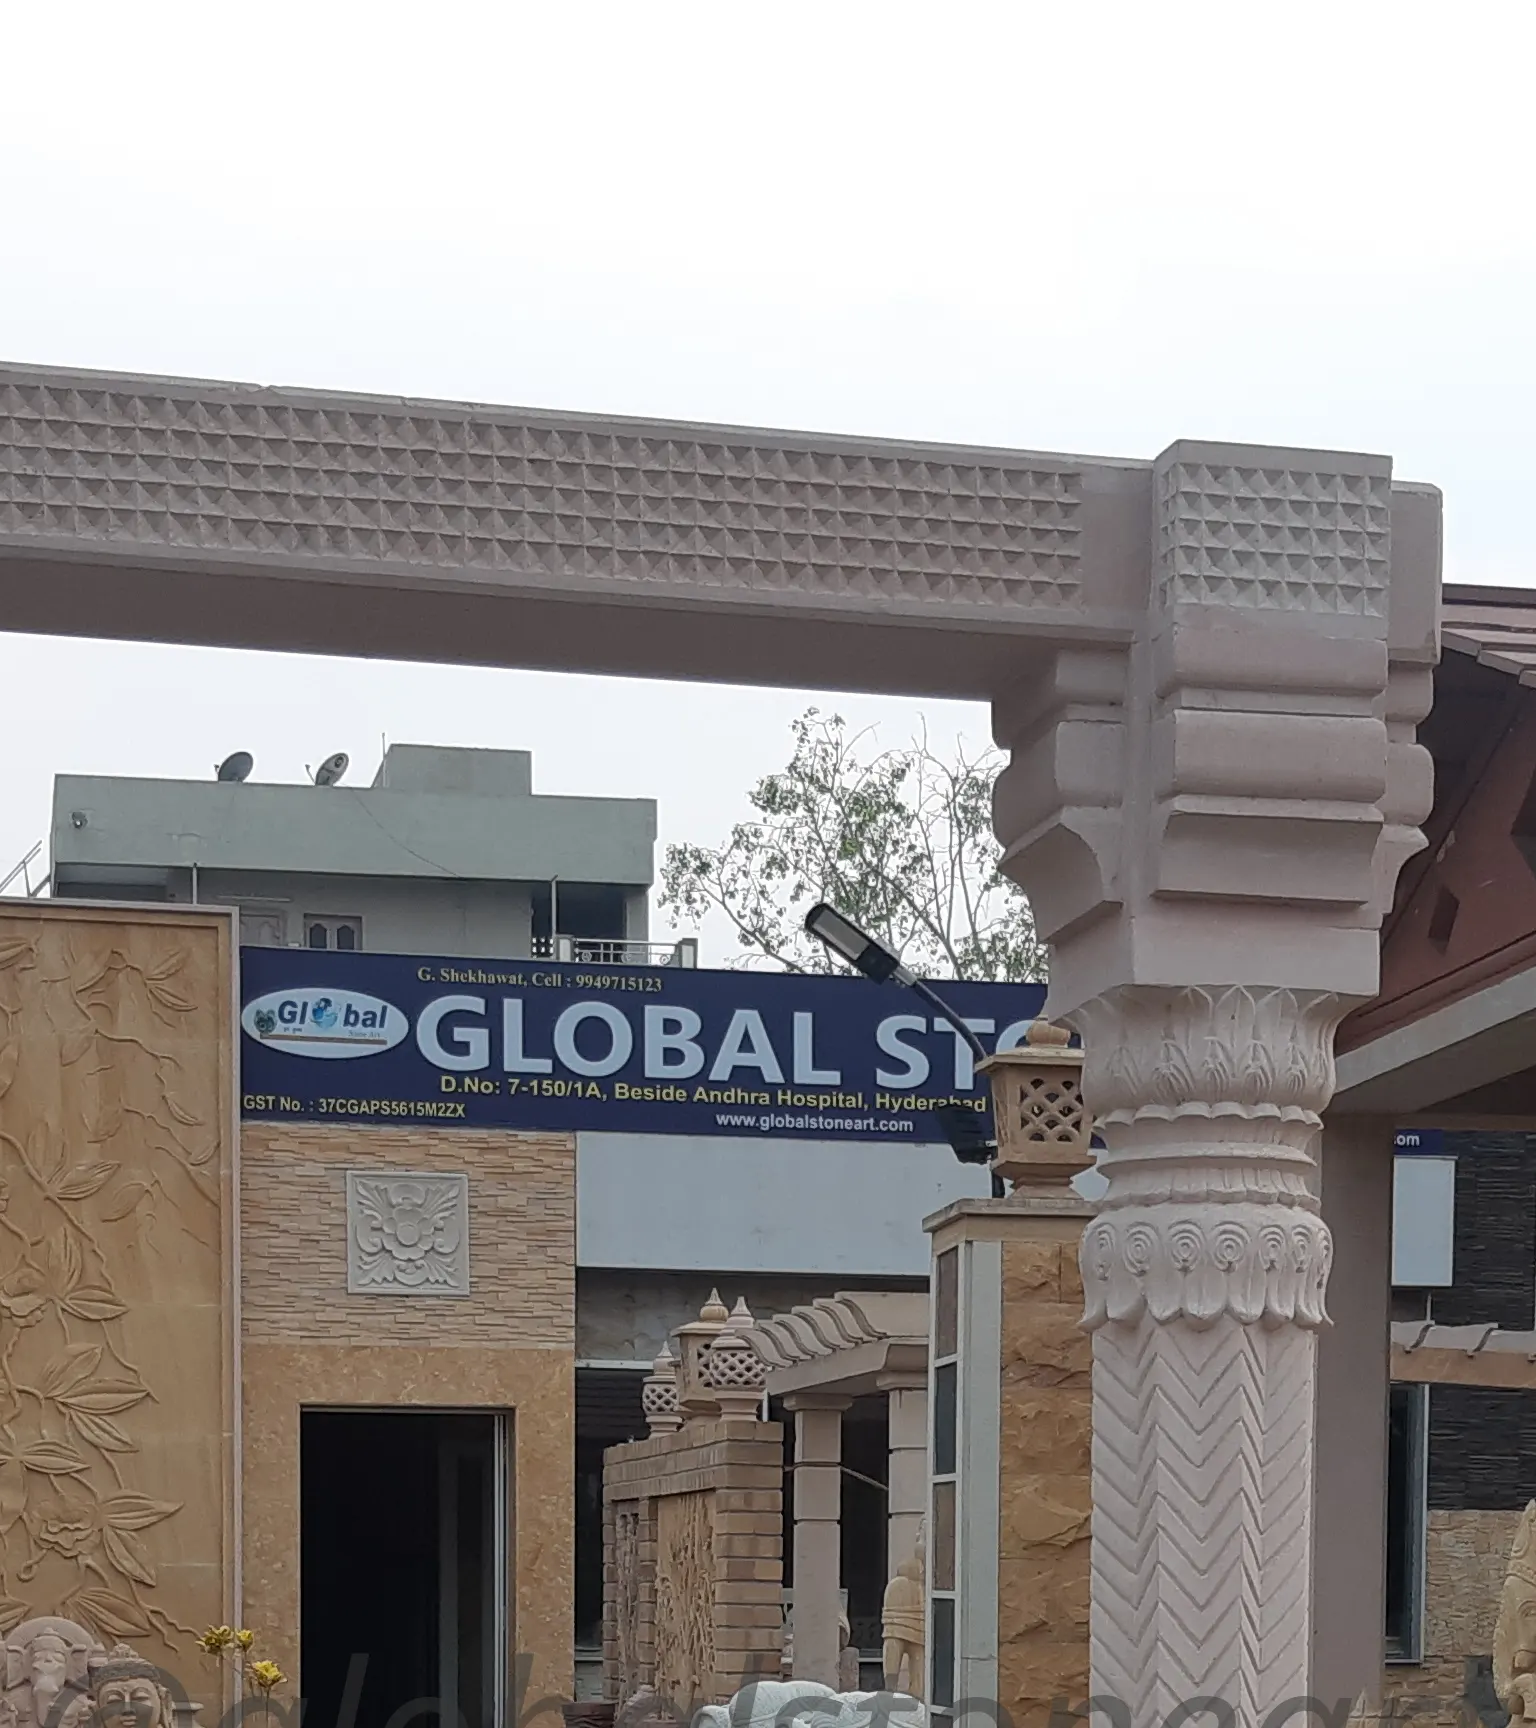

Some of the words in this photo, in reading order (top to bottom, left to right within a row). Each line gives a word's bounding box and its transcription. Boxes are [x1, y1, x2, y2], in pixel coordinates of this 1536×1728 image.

[417, 967, 435, 982] G.
[440, 969, 528, 987] Shekhawat,
[531, 972, 562, 988] Cell
[575, 974, 662, 993] 9949715123
[416, 994, 842, 1086] GLOBAL
[876, 1015, 1036, 1091] ST
[440, 1075, 501, 1095] D.No:
[507, 1078, 608, 1102] 7-150/1A,
[615, 1083, 687, 1103] Beside
[693, 1086, 770, 1107] Andhra
[778, 1089, 869, 1112] Hospital,
[243, 1095, 275, 1111] GST
[279, 1097, 305, 1112] No.
[318, 1098, 466, 1119] 37CGAPS5615M2ZX
[716, 1113, 914, 1133] www.globalstoneart.com
[1394, 1134, 1420, 1147] om
